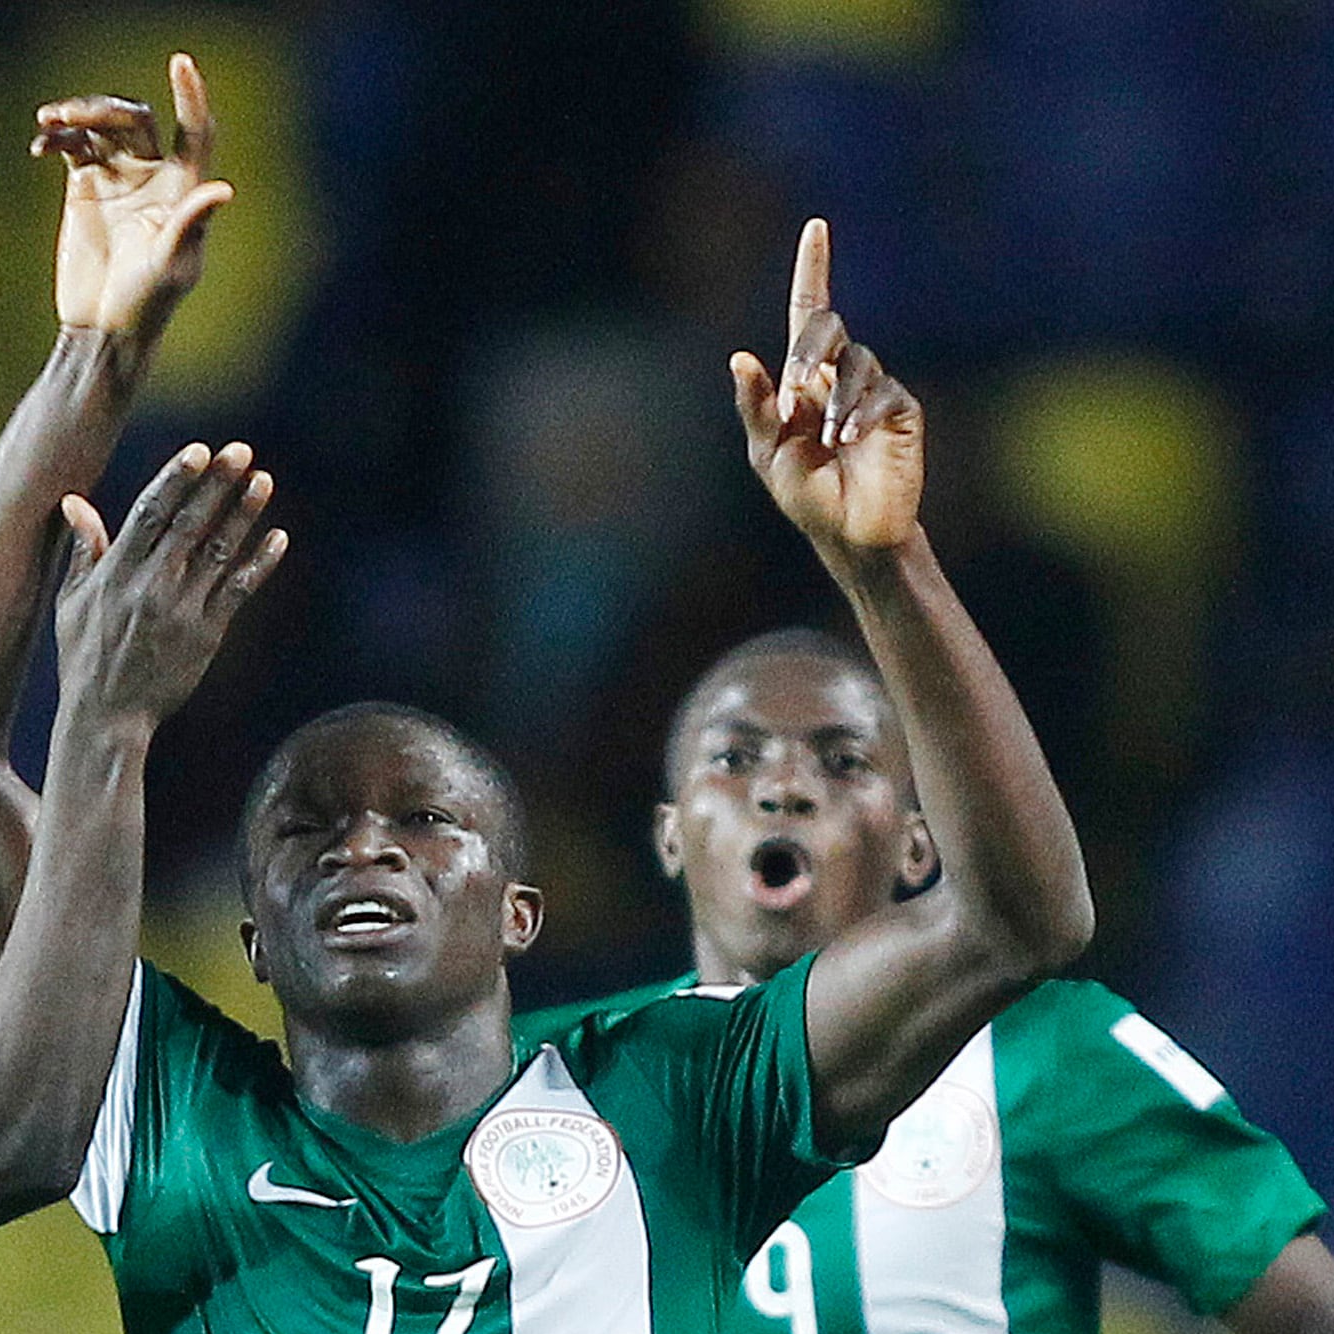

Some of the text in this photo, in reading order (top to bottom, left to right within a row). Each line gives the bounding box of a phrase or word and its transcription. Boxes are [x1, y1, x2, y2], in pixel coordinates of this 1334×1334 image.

[479, 1116, 543, 1158] FOOTBALL
[549, 1116, 612, 1178] FEDERATION
[551, 1192, 588, 1216] 1945
